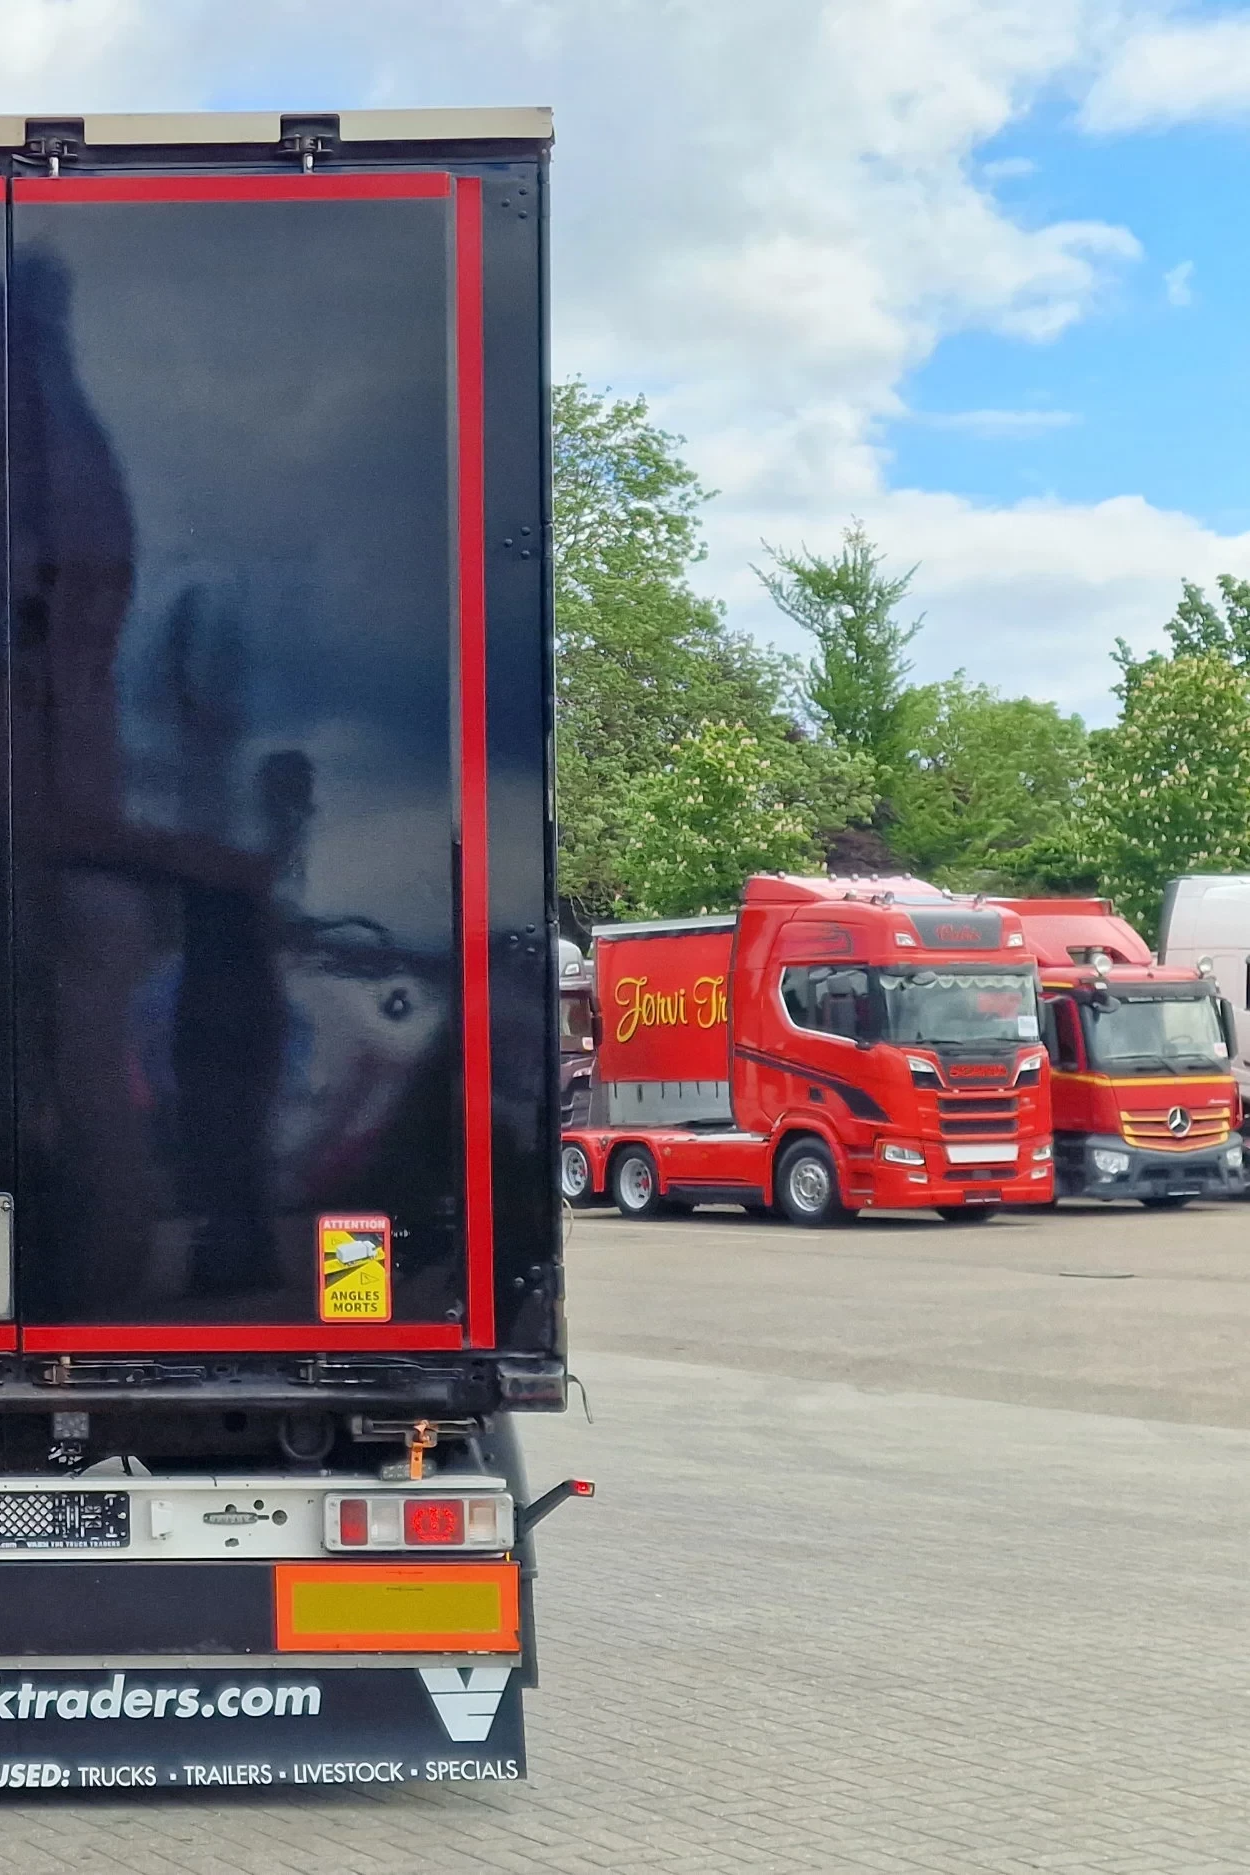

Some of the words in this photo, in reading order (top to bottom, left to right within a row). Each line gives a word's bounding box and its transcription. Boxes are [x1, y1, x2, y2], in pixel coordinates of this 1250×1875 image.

[615, 976, 688, 1043] Jørvi
[323, 1220, 386, 1230] ATTENTION
[331, 1290, 380, 1301] ANGLES
[333, 1302, 378, 1313] MORTS
[66, 1540, 88, 1548] TRUCK
[78, 1765, 157, 1787] TRUCKS
[183, 1763, 273, 1786] TRAILERS
[294, 1761, 405, 1785] LIVESTOCK
[425, 1758, 519, 1782] SPECIALS
